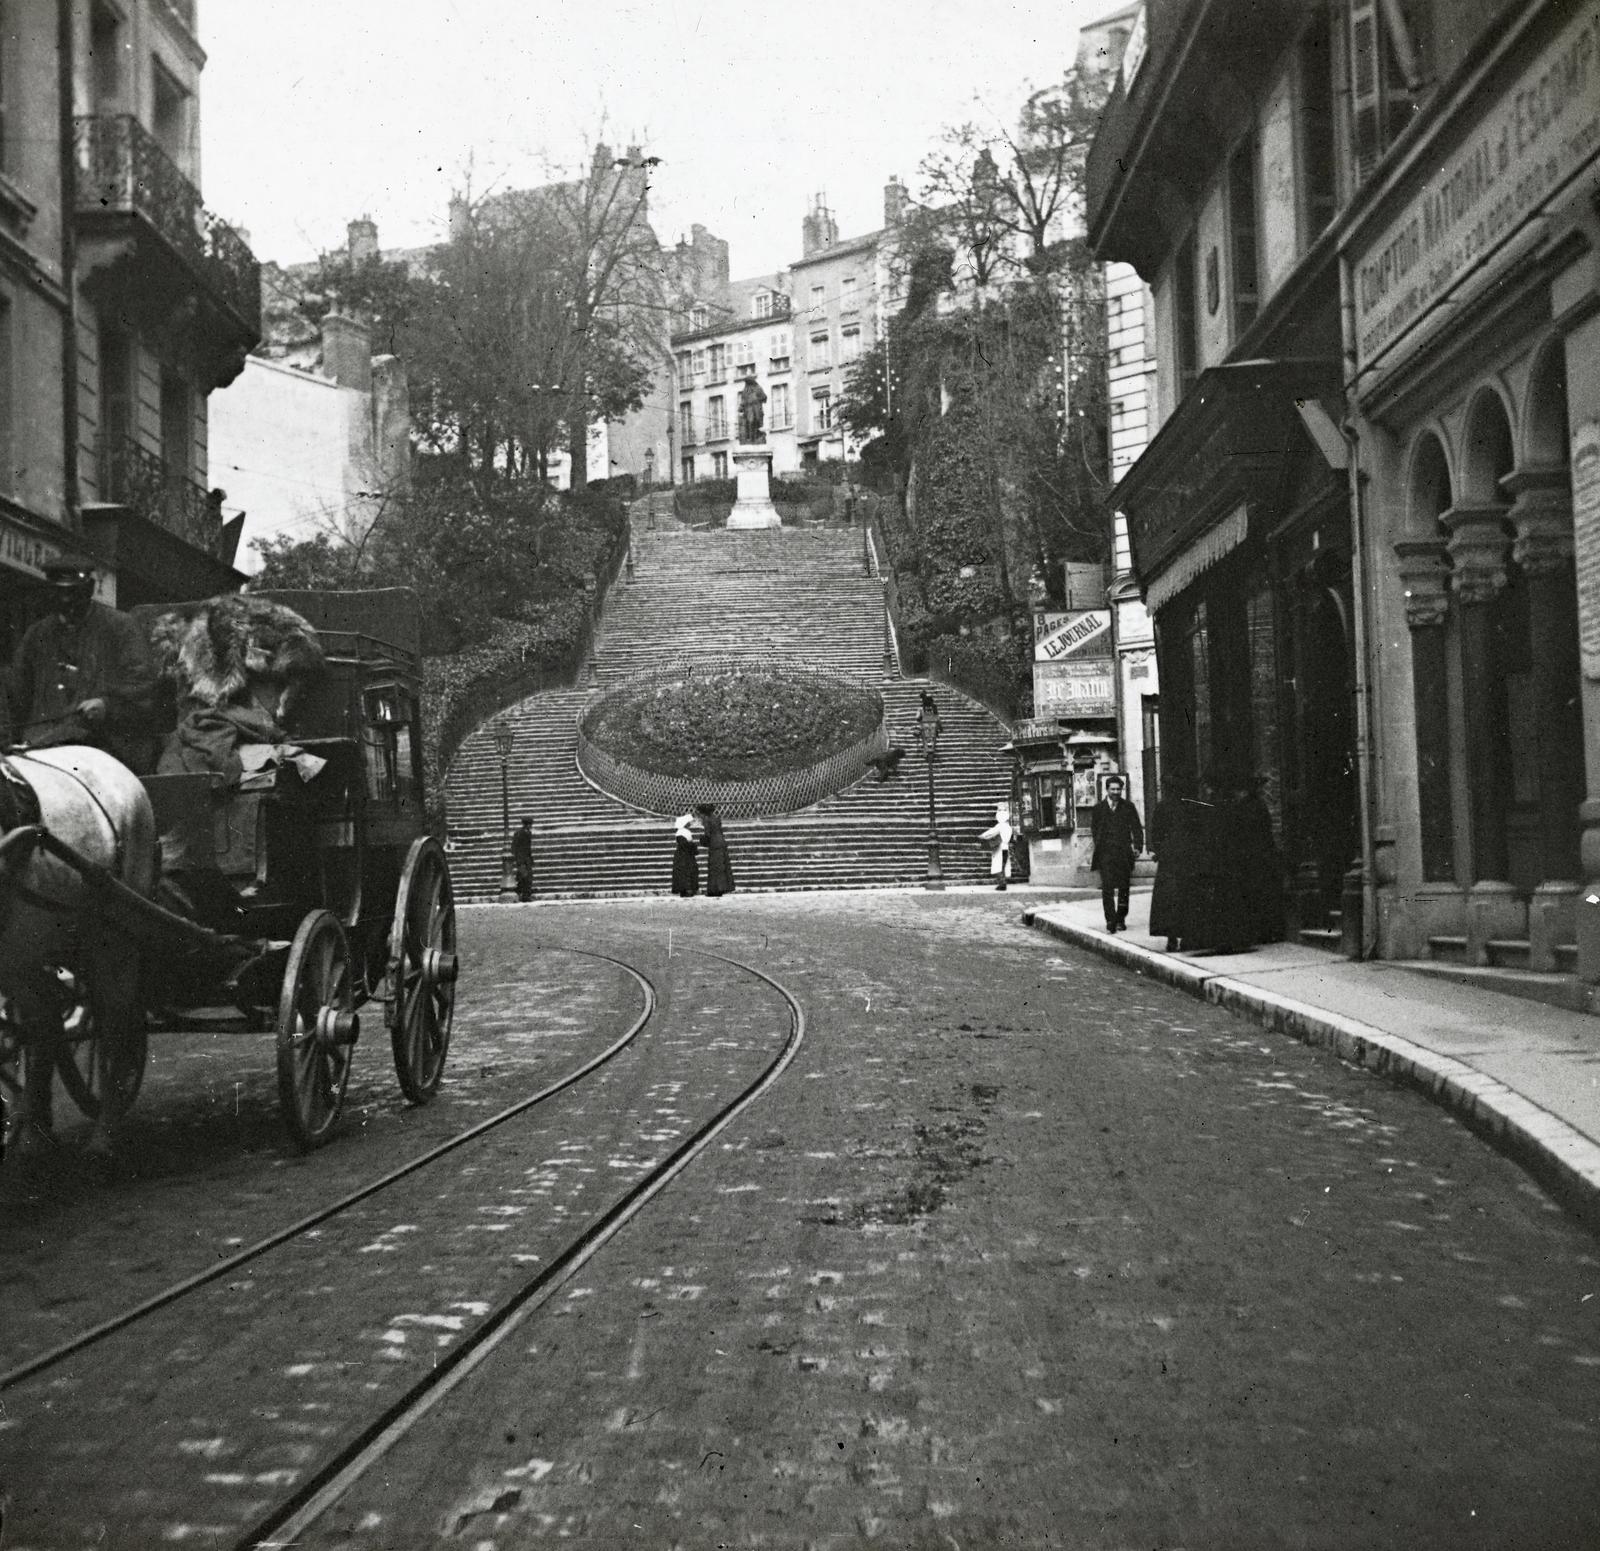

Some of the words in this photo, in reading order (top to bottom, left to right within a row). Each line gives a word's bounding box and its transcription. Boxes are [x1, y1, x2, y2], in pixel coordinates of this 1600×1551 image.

[1036, 616, 1069, 641] PAGES
[1043, 640, 1061, 658] LE
[1057, 614, 1103, 651] JOURNAL
